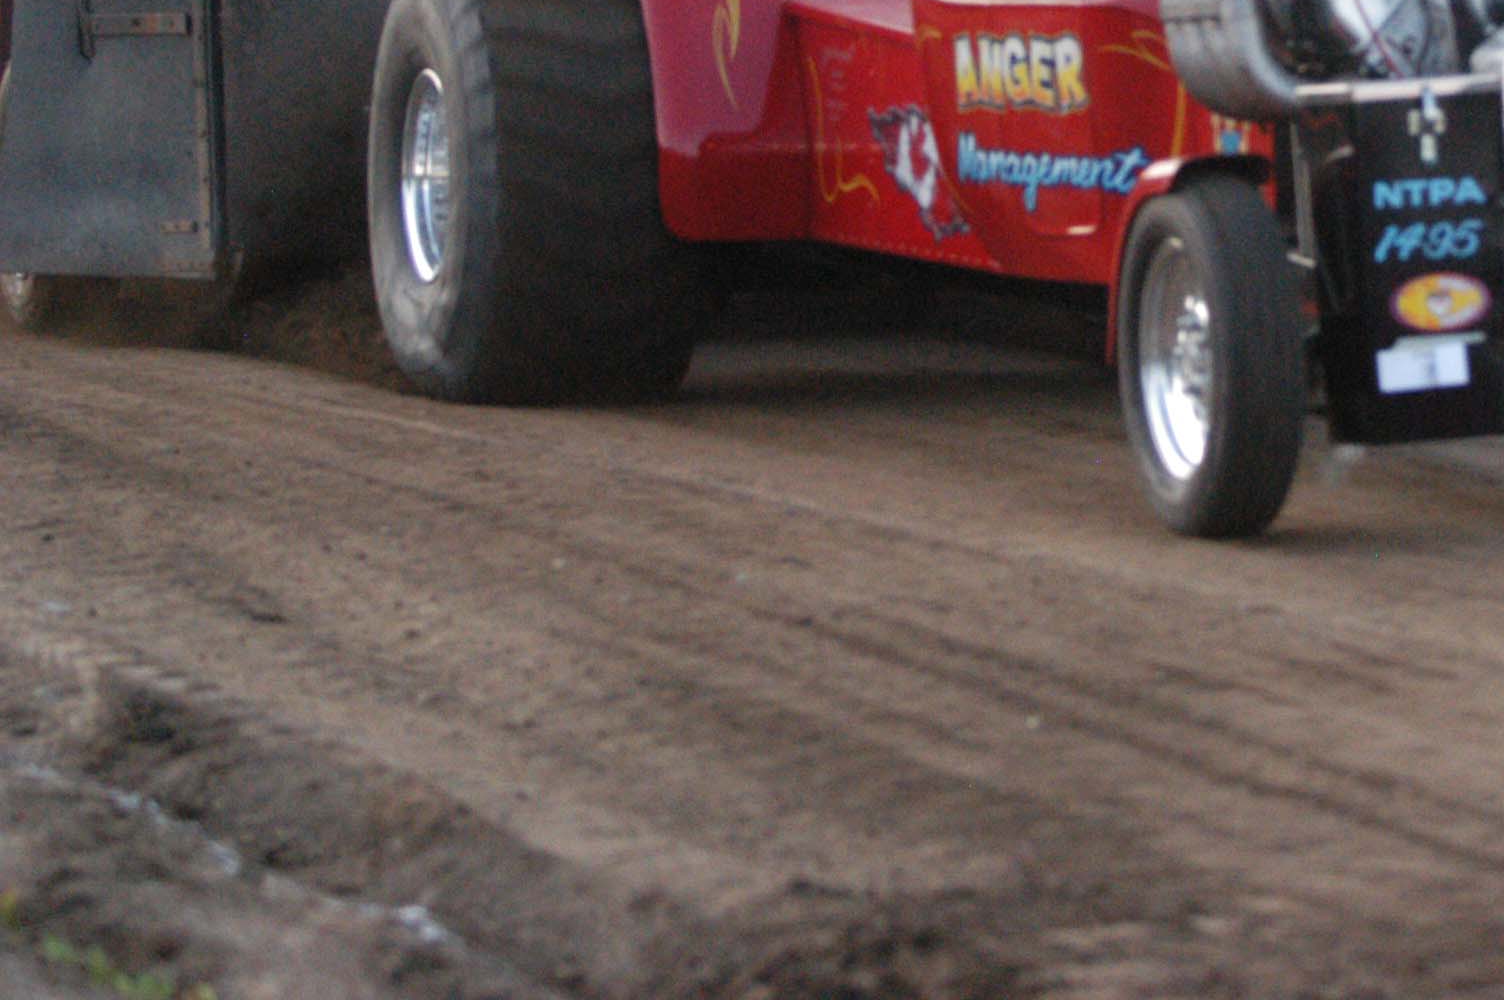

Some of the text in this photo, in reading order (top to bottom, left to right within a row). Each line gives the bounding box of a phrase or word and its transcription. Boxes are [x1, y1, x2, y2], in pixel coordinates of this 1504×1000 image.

[954, 30, 1090, 116] ANGER
[957, 132, 1151, 213] Management
[1372, 175, 1487, 209] NTPA
[1374, 218, 1484, 263] 1495
